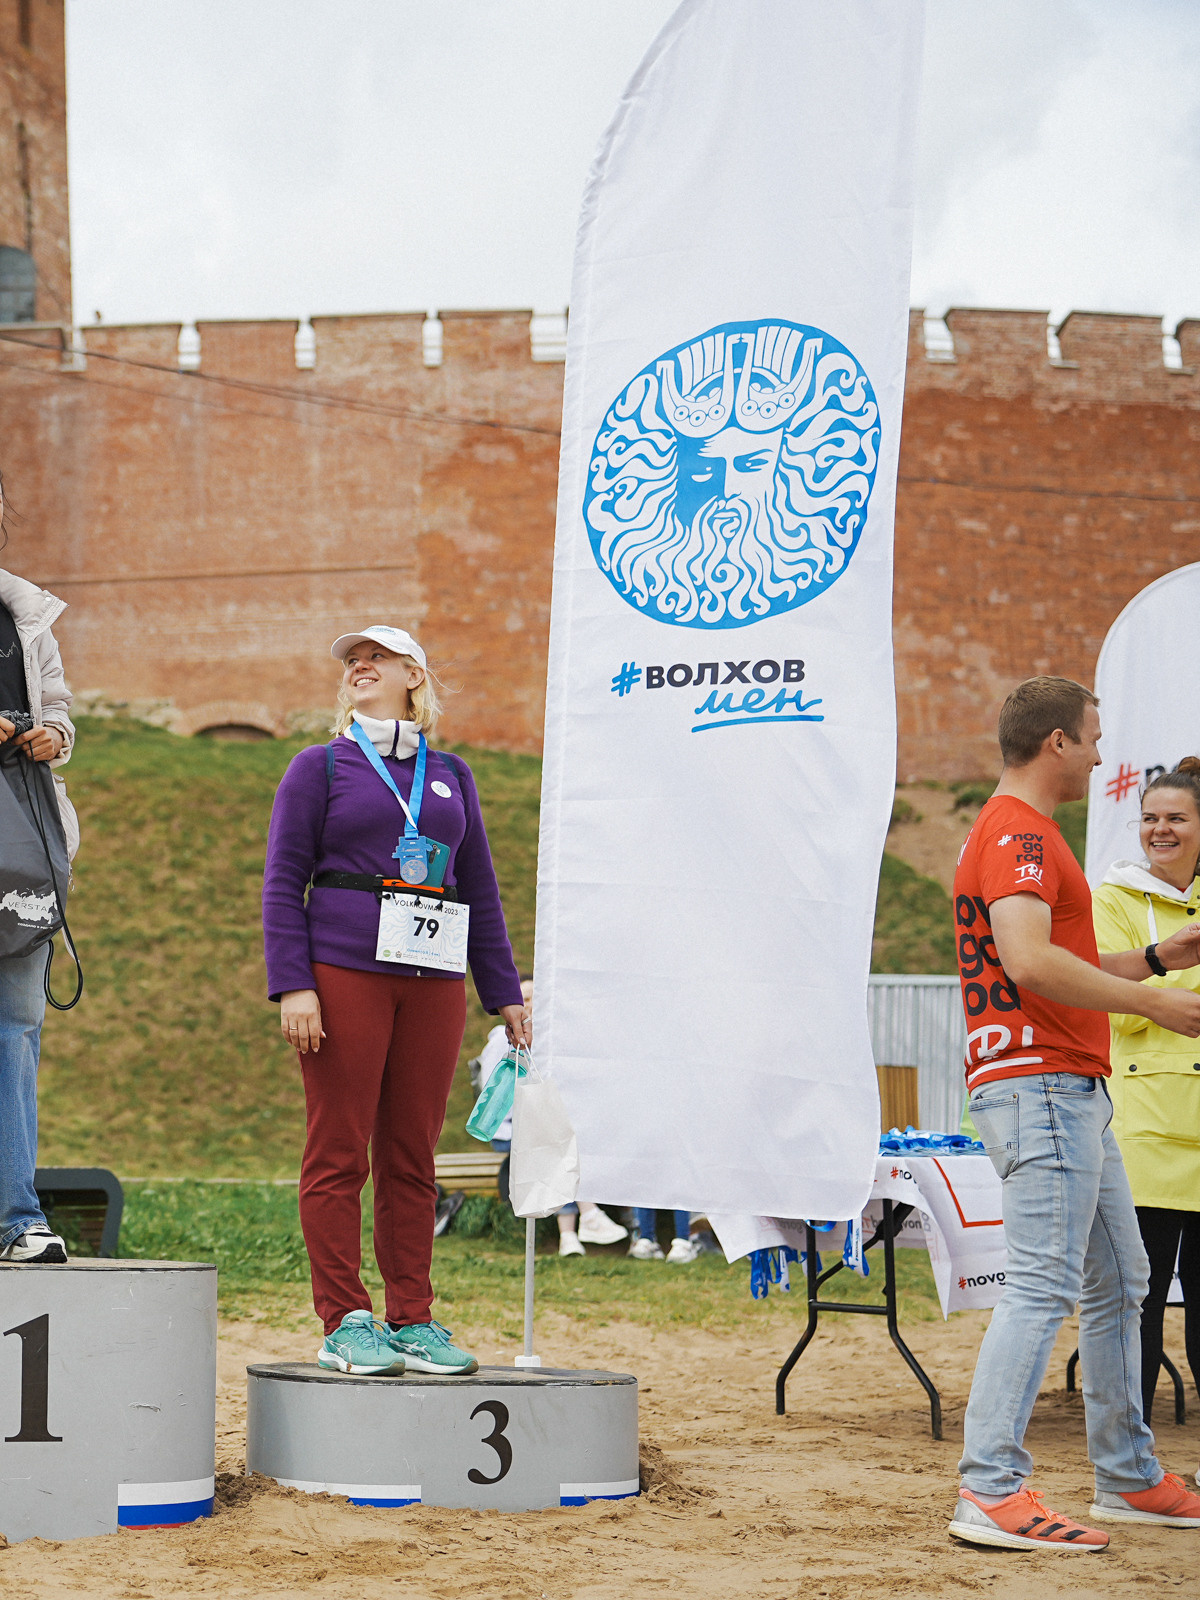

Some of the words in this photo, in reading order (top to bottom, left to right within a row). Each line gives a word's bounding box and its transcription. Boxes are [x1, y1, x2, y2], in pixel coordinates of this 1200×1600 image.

[611, 659, 806, 697] #ВОЛХОВ
[694, 688, 823, 715] мен
[997, 833, 1043, 847] #nov
[1022, 842, 1043, 854] go
[1016, 853, 1043, 865] rod
[8, 901, 48, 912] VERSTA
[444, 907, 459, 916] 2023
[413, 916, 440, 939] 79
[964, 977, 1022, 1017] od
[3, 1313, 63, 1442] 1
[467, 1400, 513, 1485] 3
